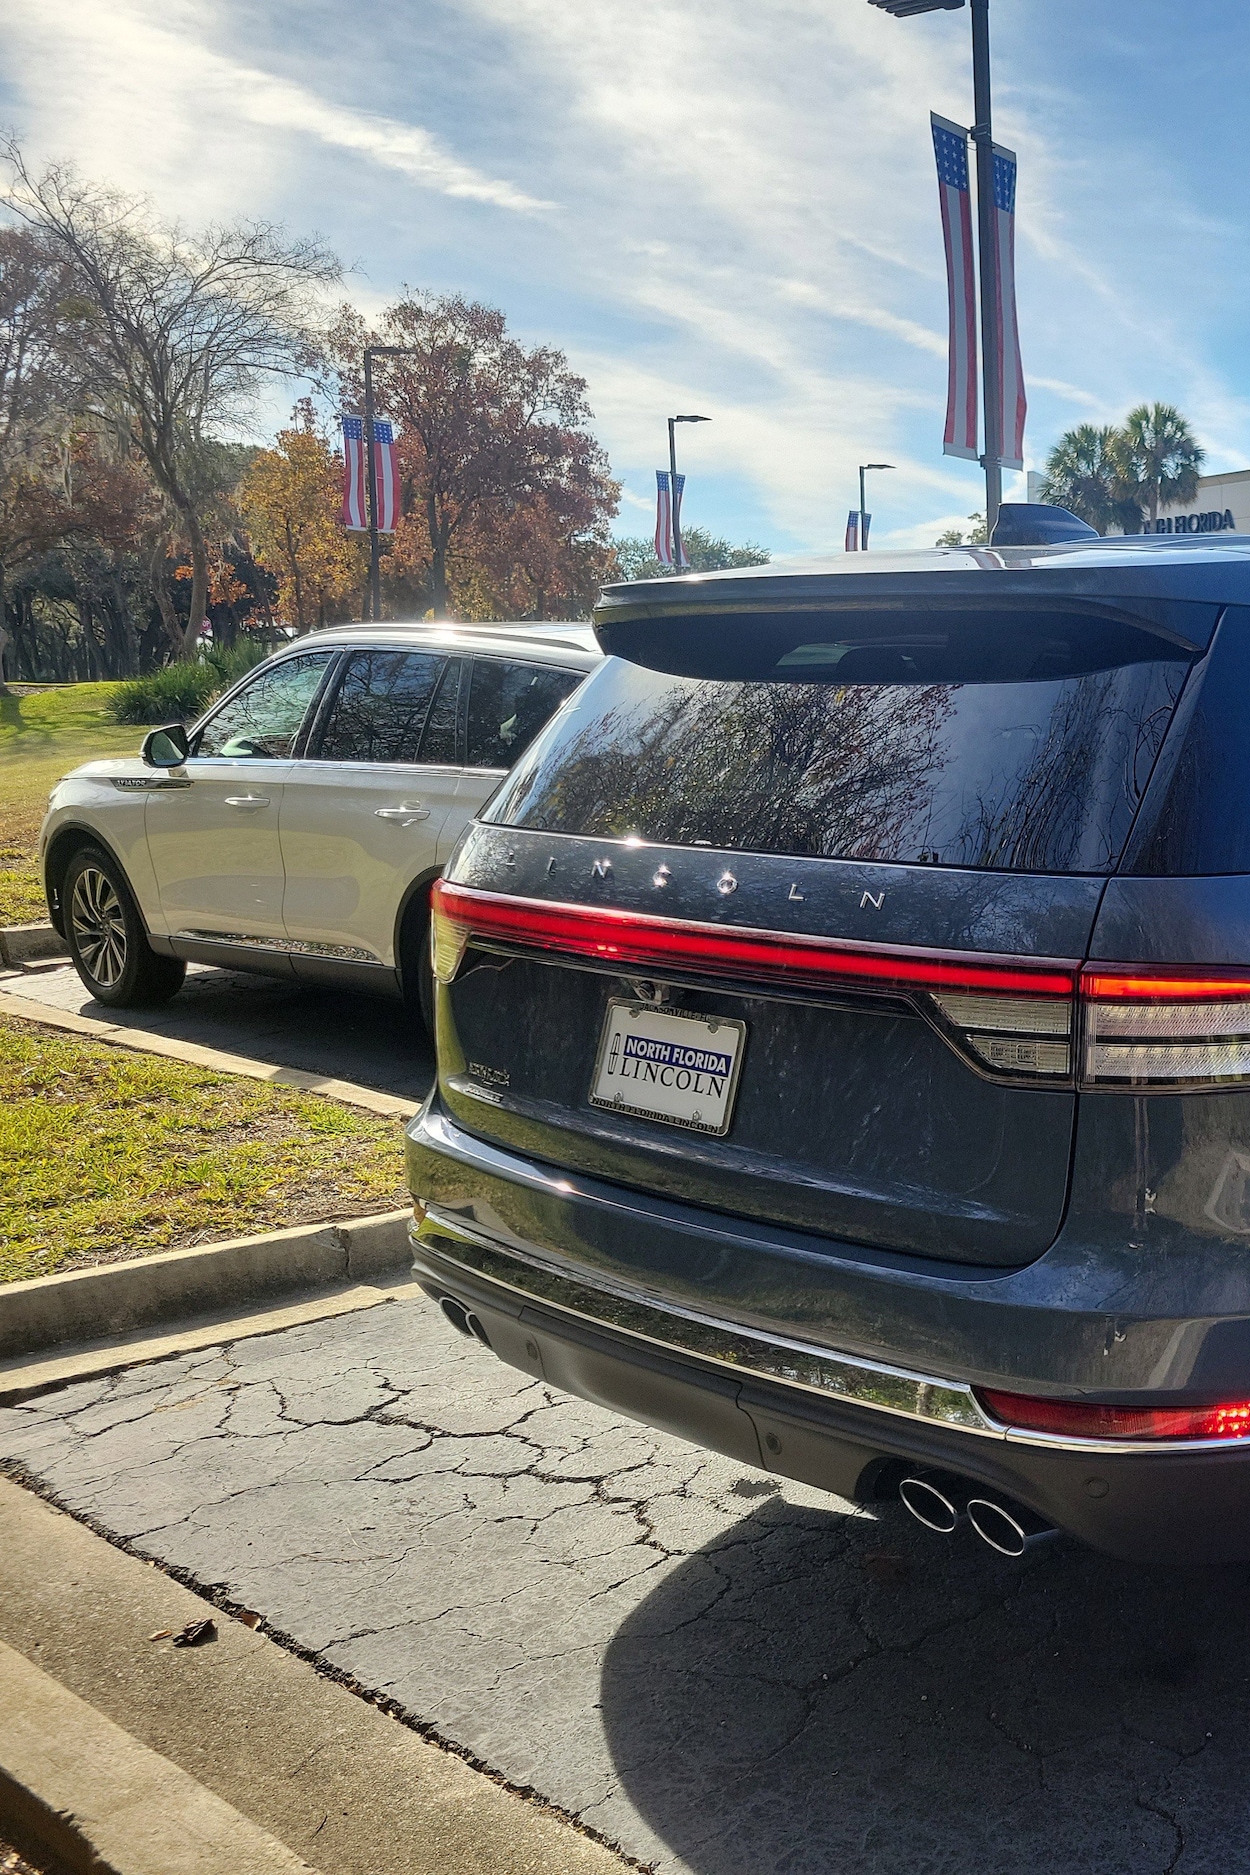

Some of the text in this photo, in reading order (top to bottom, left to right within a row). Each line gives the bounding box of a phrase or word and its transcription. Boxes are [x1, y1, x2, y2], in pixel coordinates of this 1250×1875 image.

[505, 851, 886, 911] LINCOLN
[626, 1037, 727, 1074] NORTH FLORIDA
[619, 1057, 727, 1099] LINCOLN
[590, 1096, 719, 1134] NORTH FLORIDA LINCOLN
